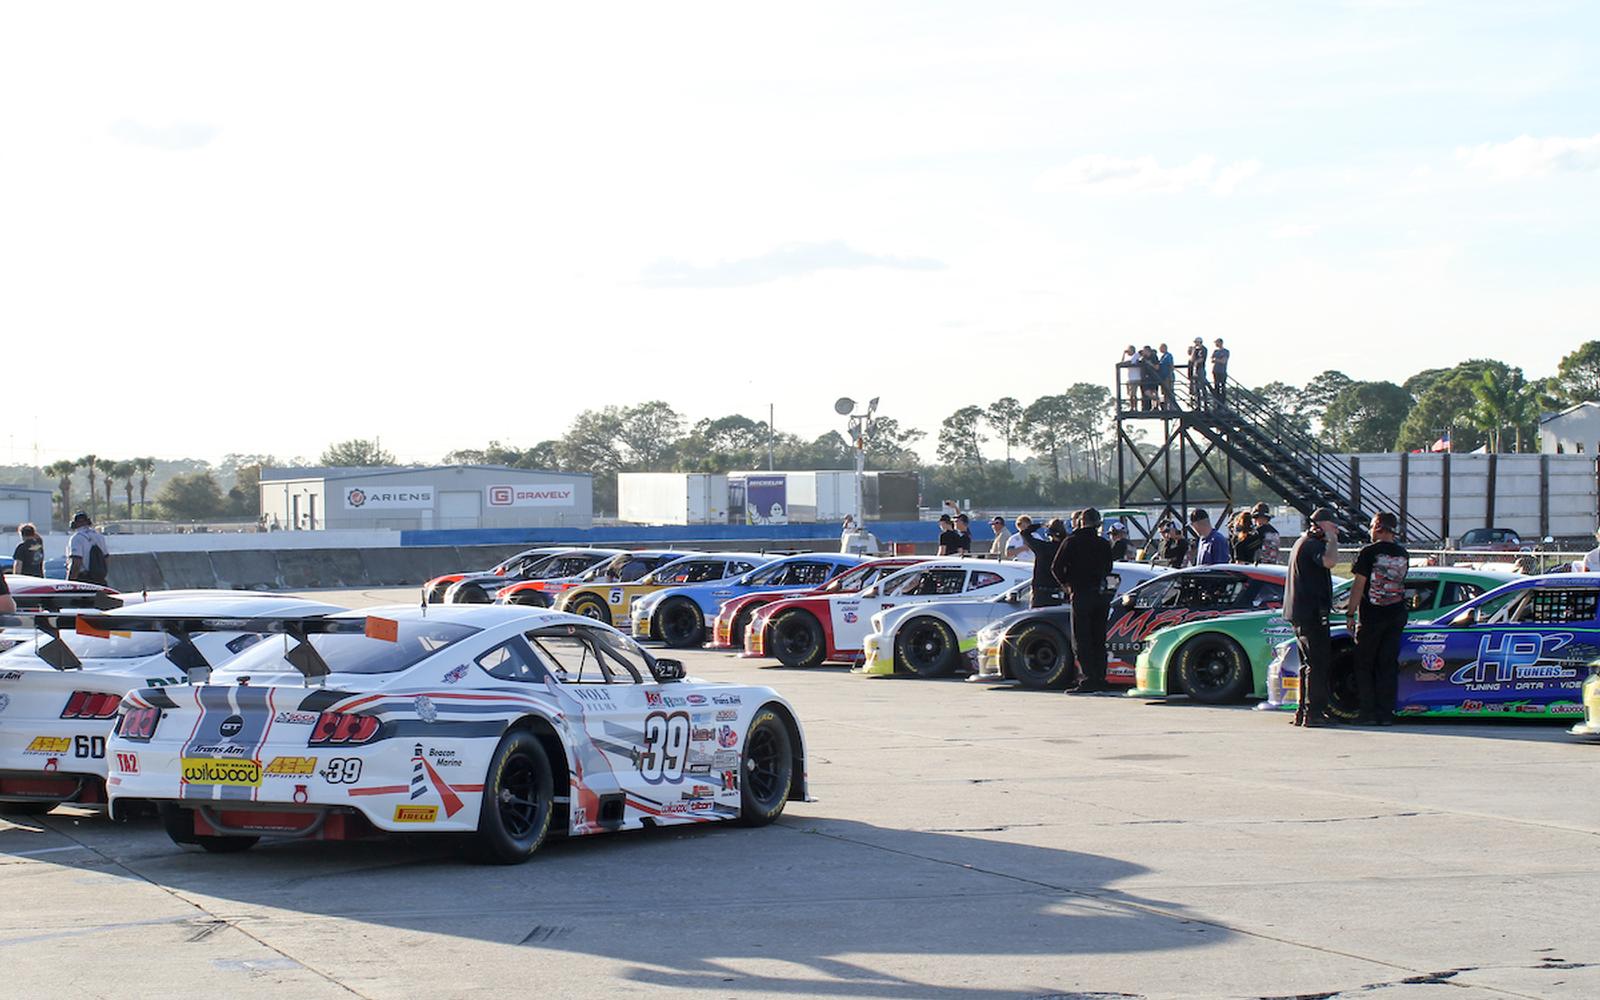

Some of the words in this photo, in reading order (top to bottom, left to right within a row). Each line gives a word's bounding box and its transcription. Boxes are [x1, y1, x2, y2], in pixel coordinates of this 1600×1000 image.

[370, 492, 431, 502] ARIENS
[517, 490, 571, 500] GRAVELY
[611, 591, 621, 604] 5
[1475, 633, 1543, 682] HP
[1465, 683, 1501, 691] TUNING
[1515, 681, 1544, 690] DATA
[574, 688, 611, 700] WOLF
[222, 722, 241, 731] GT
[26, 736, 72, 753] AEM
[74, 735, 106, 759] 60
[193, 744, 223, 753] Trans
[224, 745, 246, 755] Am
[640, 710, 691, 785] 39
[429, 748, 456, 757] Beacon
[117, 753, 138, 773] TA2
[265, 756, 318, 774] AEM
[436, 758, 463, 767] Marine
[184, 762, 260, 783] wilwood
[326, 757, 363, 784] 39
[398, 808, 435, 820] PIRELLI
